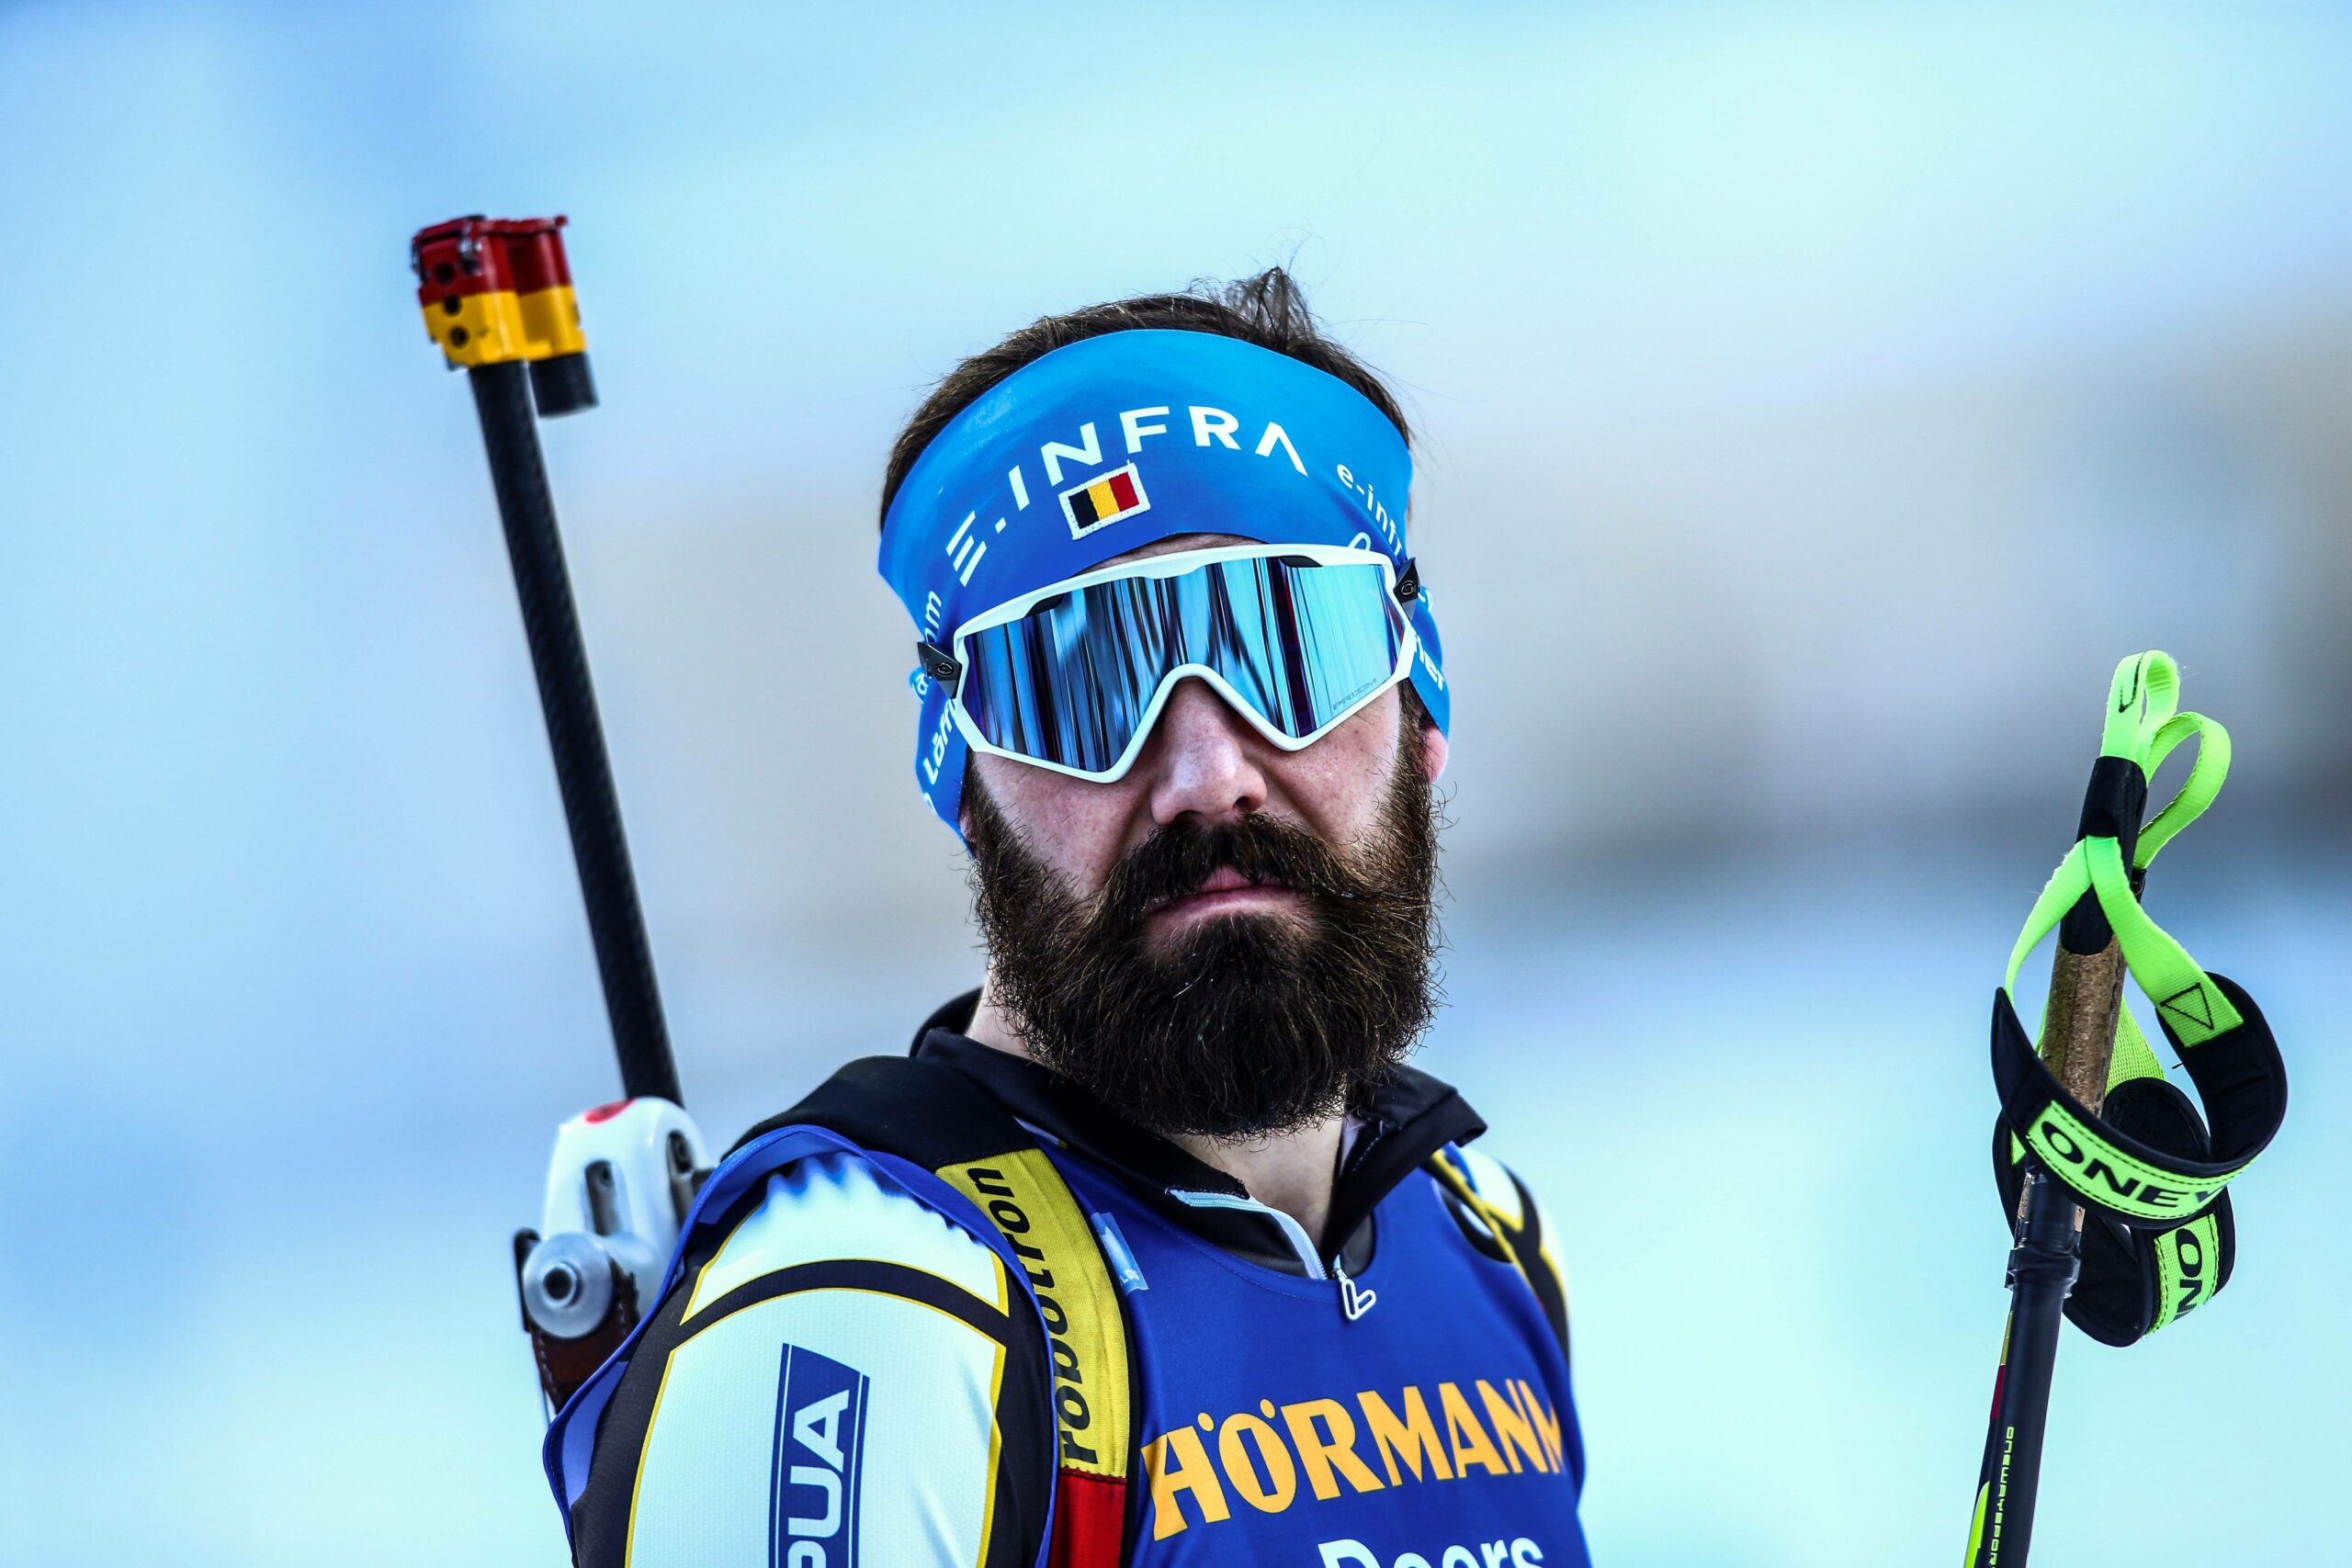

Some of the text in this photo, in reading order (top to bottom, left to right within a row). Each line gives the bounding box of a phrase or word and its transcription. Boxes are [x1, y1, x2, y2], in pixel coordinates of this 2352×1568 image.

[967, 1168, 1099, 1464] robotron
[2174, 1228, 2203, 1321] ON
[1140, 1379, 1563, 1541] HÖRMANN
[1988, 1427, 2015, 1568] ONEWAYSPOR
